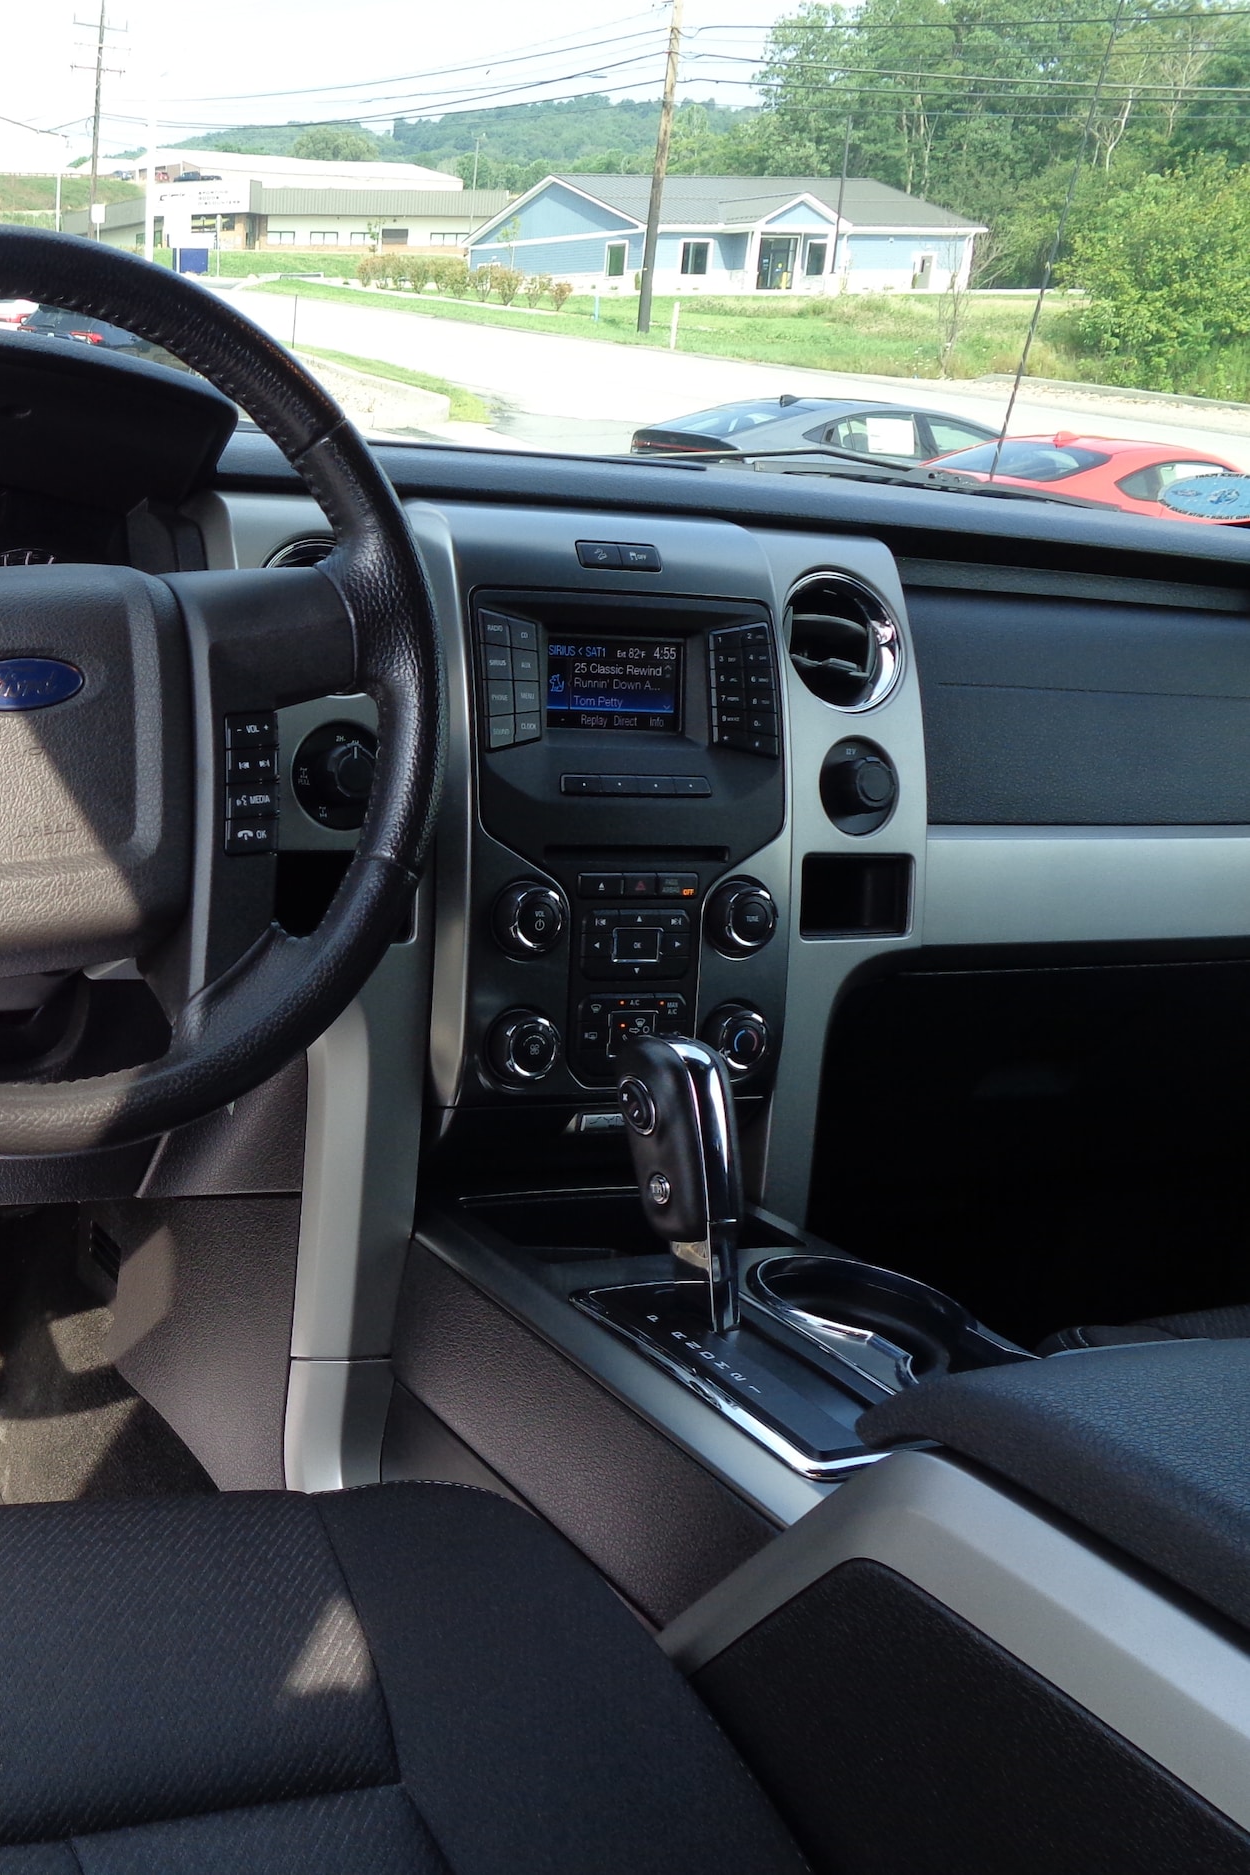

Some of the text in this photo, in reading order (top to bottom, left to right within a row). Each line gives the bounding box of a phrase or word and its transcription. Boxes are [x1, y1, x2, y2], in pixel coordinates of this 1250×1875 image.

[487, 624, 503, 632] RADIO
[549, 645, 606, 658] SIRIUS SAT1
[616, 650, 627, 658] Ext
[653, 647, 677, 660] 4:55
[574, 662, 662, 677] 25 Classic Rewind
[573, 677, 610, 689] Runnin'
[612, 679, 642, 690] Down
[520, 692, 535, 700] MENU
[573, 695, 623, 709] Tom Petty
[580, 713, 608, 728] Replay
[613, 715, 638, 727] Direct
[649, 717, 665, 728] Info
[245, 725, 260, 734] VOL
[249, 794, 271, 805] MEDIA
[256, 830, 267, 839] OK
[682, 888, 695, 896] OFF
[746, 915, 760, 923] TUNE
[646, 1314, 659, 1323] P
[671, 1331, 687, 1340] R
[685, 1341, 702, 1350] N
[699, 1351, 715, 1360] D
[730, 1372, 747, 1381] 2
